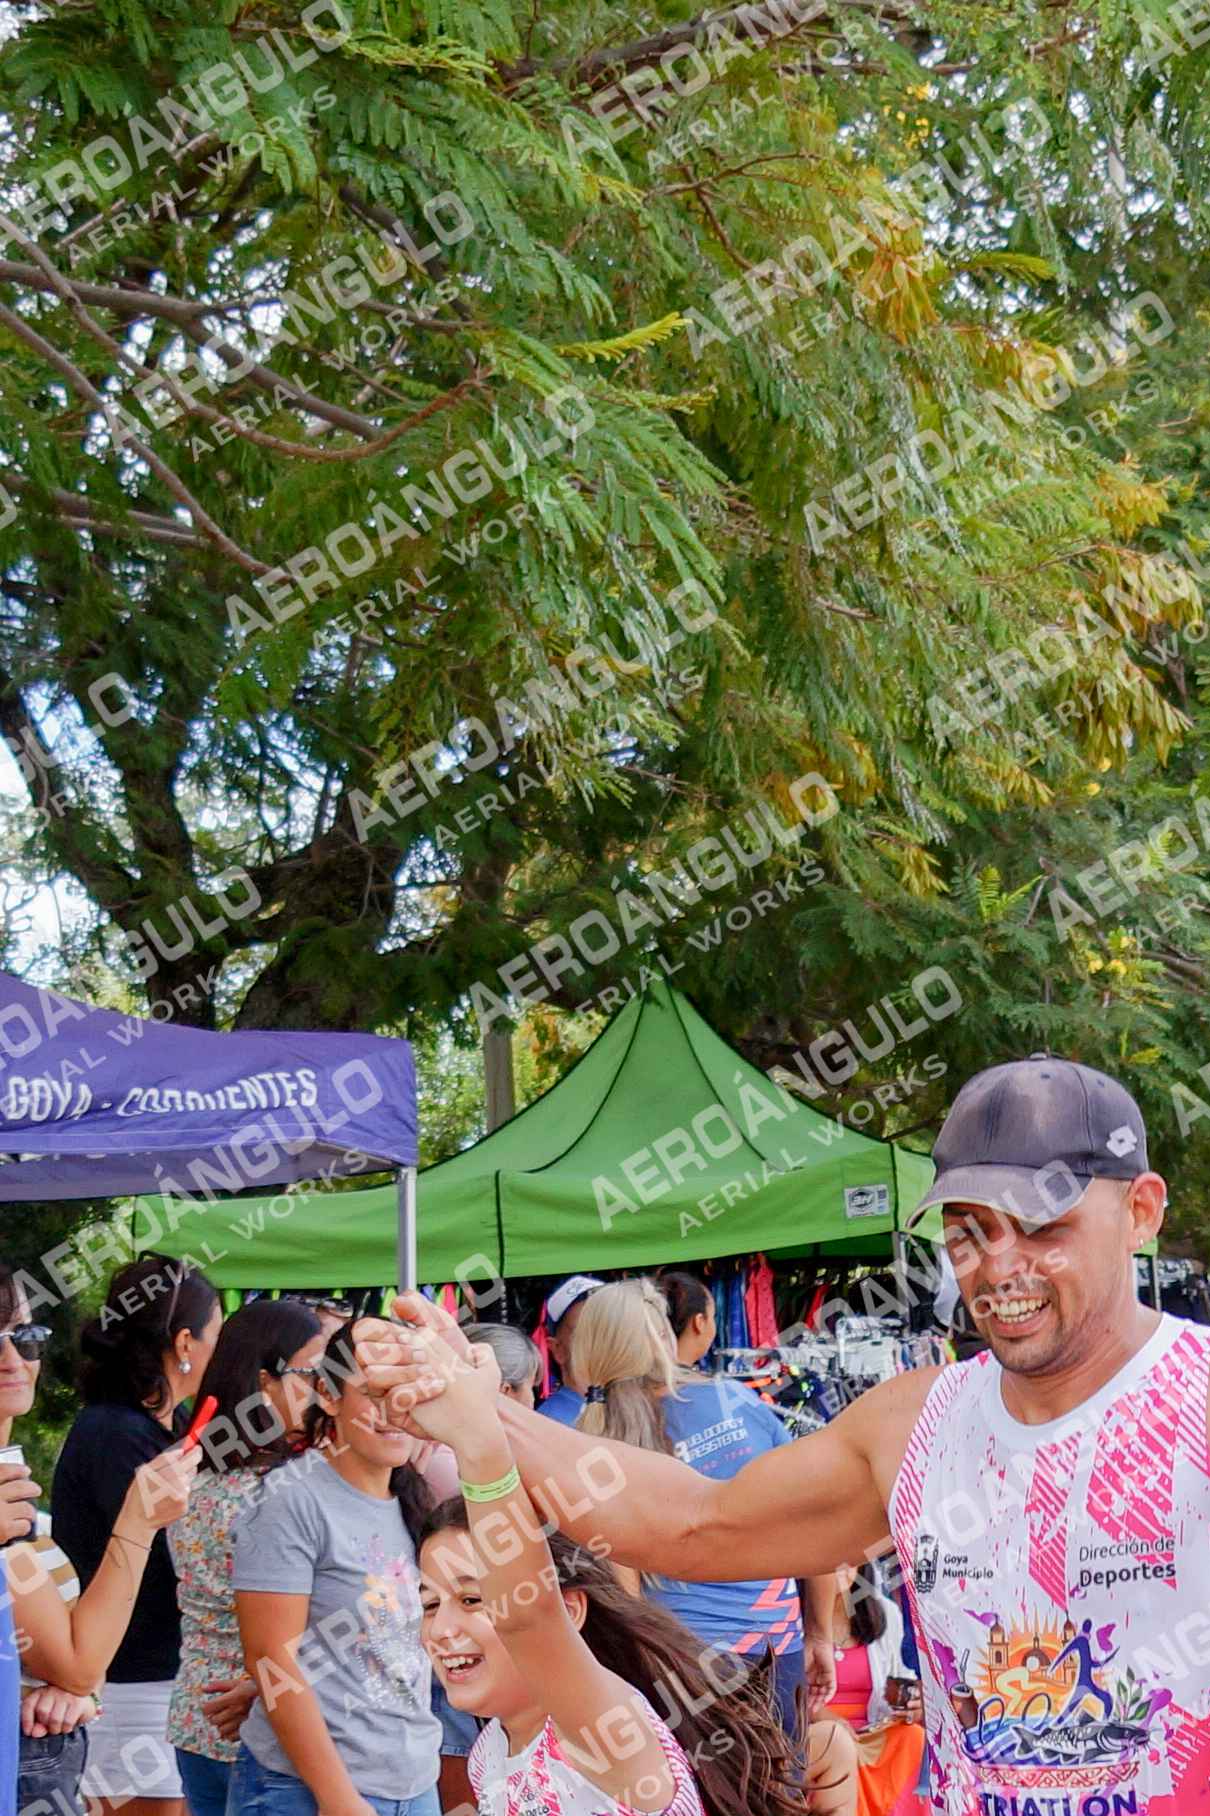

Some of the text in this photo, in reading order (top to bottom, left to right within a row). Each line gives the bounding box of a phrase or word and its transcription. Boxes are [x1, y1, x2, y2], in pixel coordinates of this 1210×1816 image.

[5, 1075, 92, 1121] GOYA
[943, 1554, 968, 1566] Goya
[1079, 1537, 1175, 1562] Dirección de
[1079, 1562, 1176, 1588] Deportes
